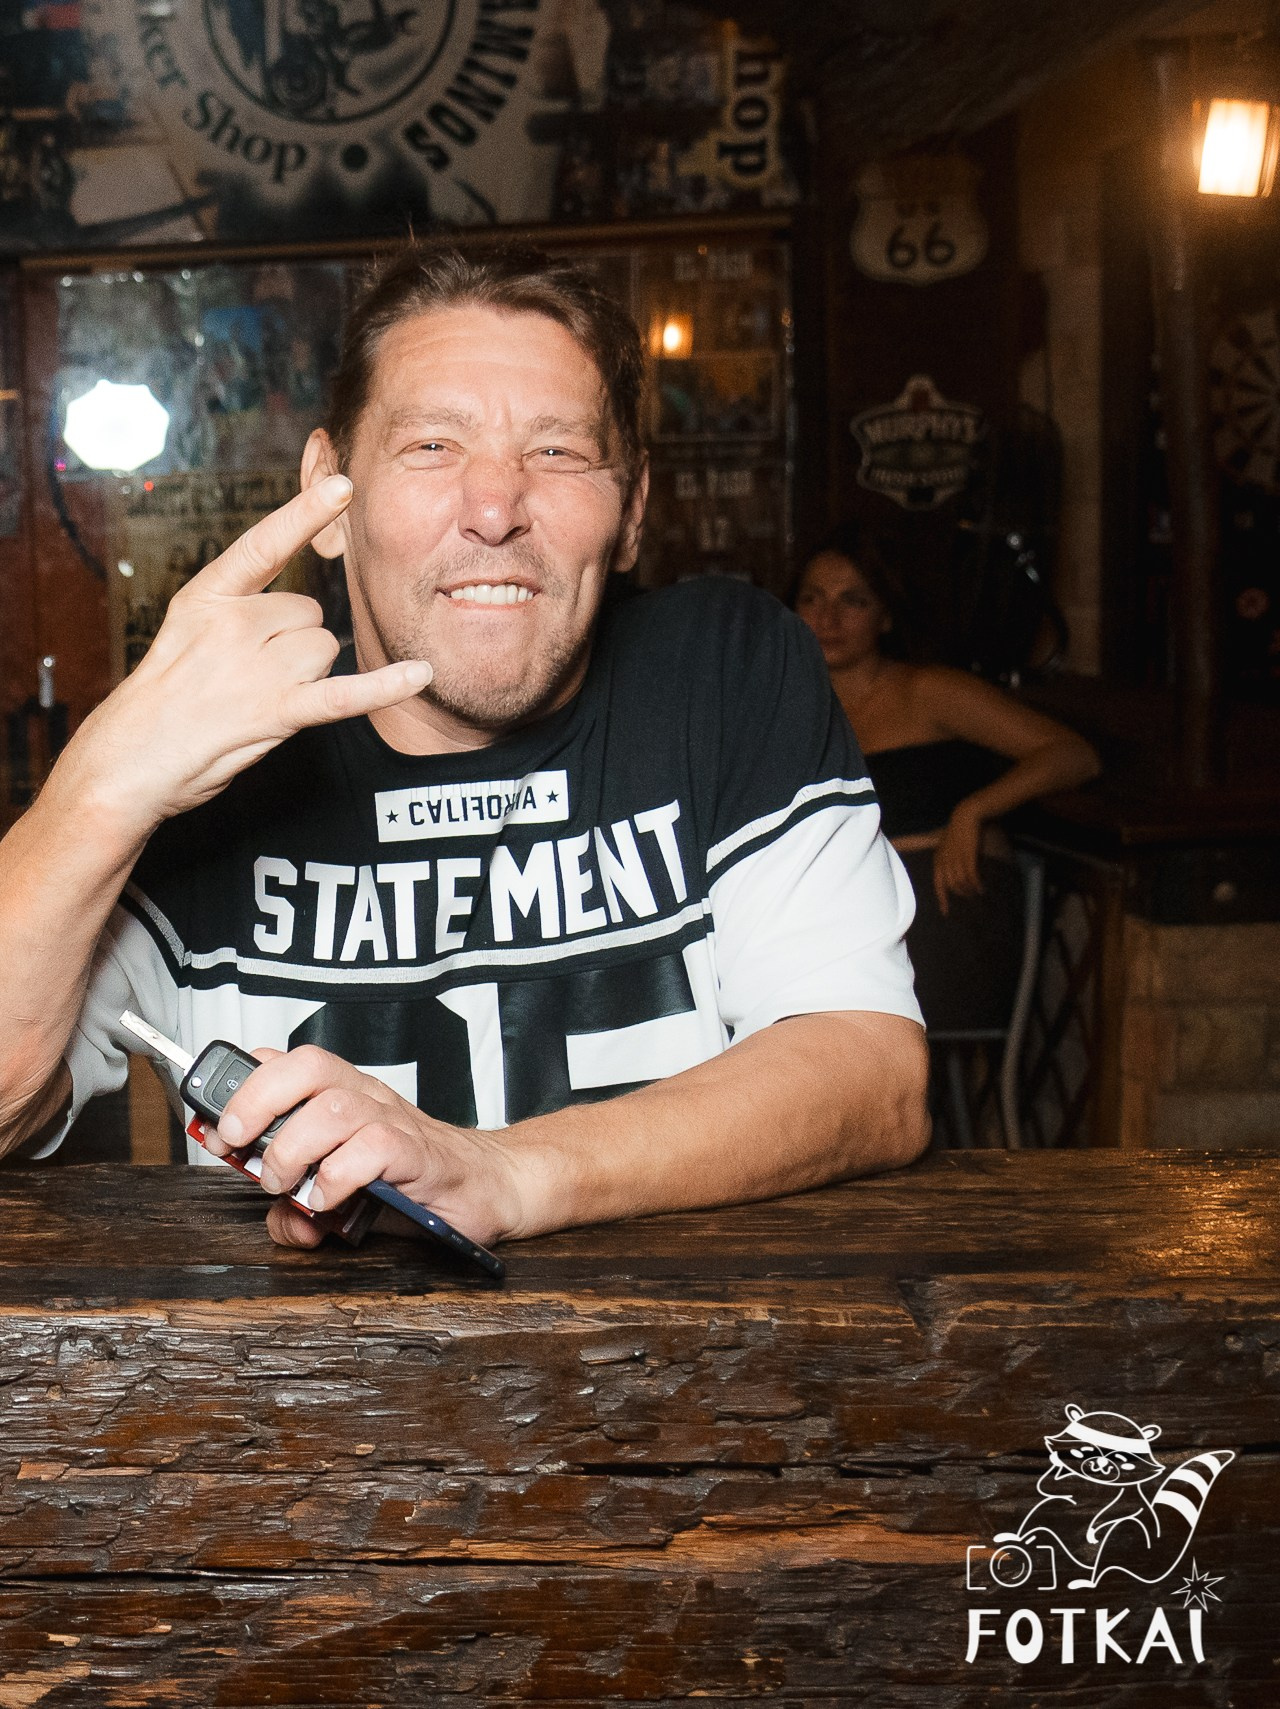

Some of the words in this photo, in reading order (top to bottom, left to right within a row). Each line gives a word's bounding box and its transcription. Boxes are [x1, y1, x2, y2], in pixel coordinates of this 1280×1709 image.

[182, 90, 308, 183] Shop
[887, 221, 955, 269] 66
[408, 785, 538, 827] CALIFORIA
[252, 799, 688, 962] STATEMENT
